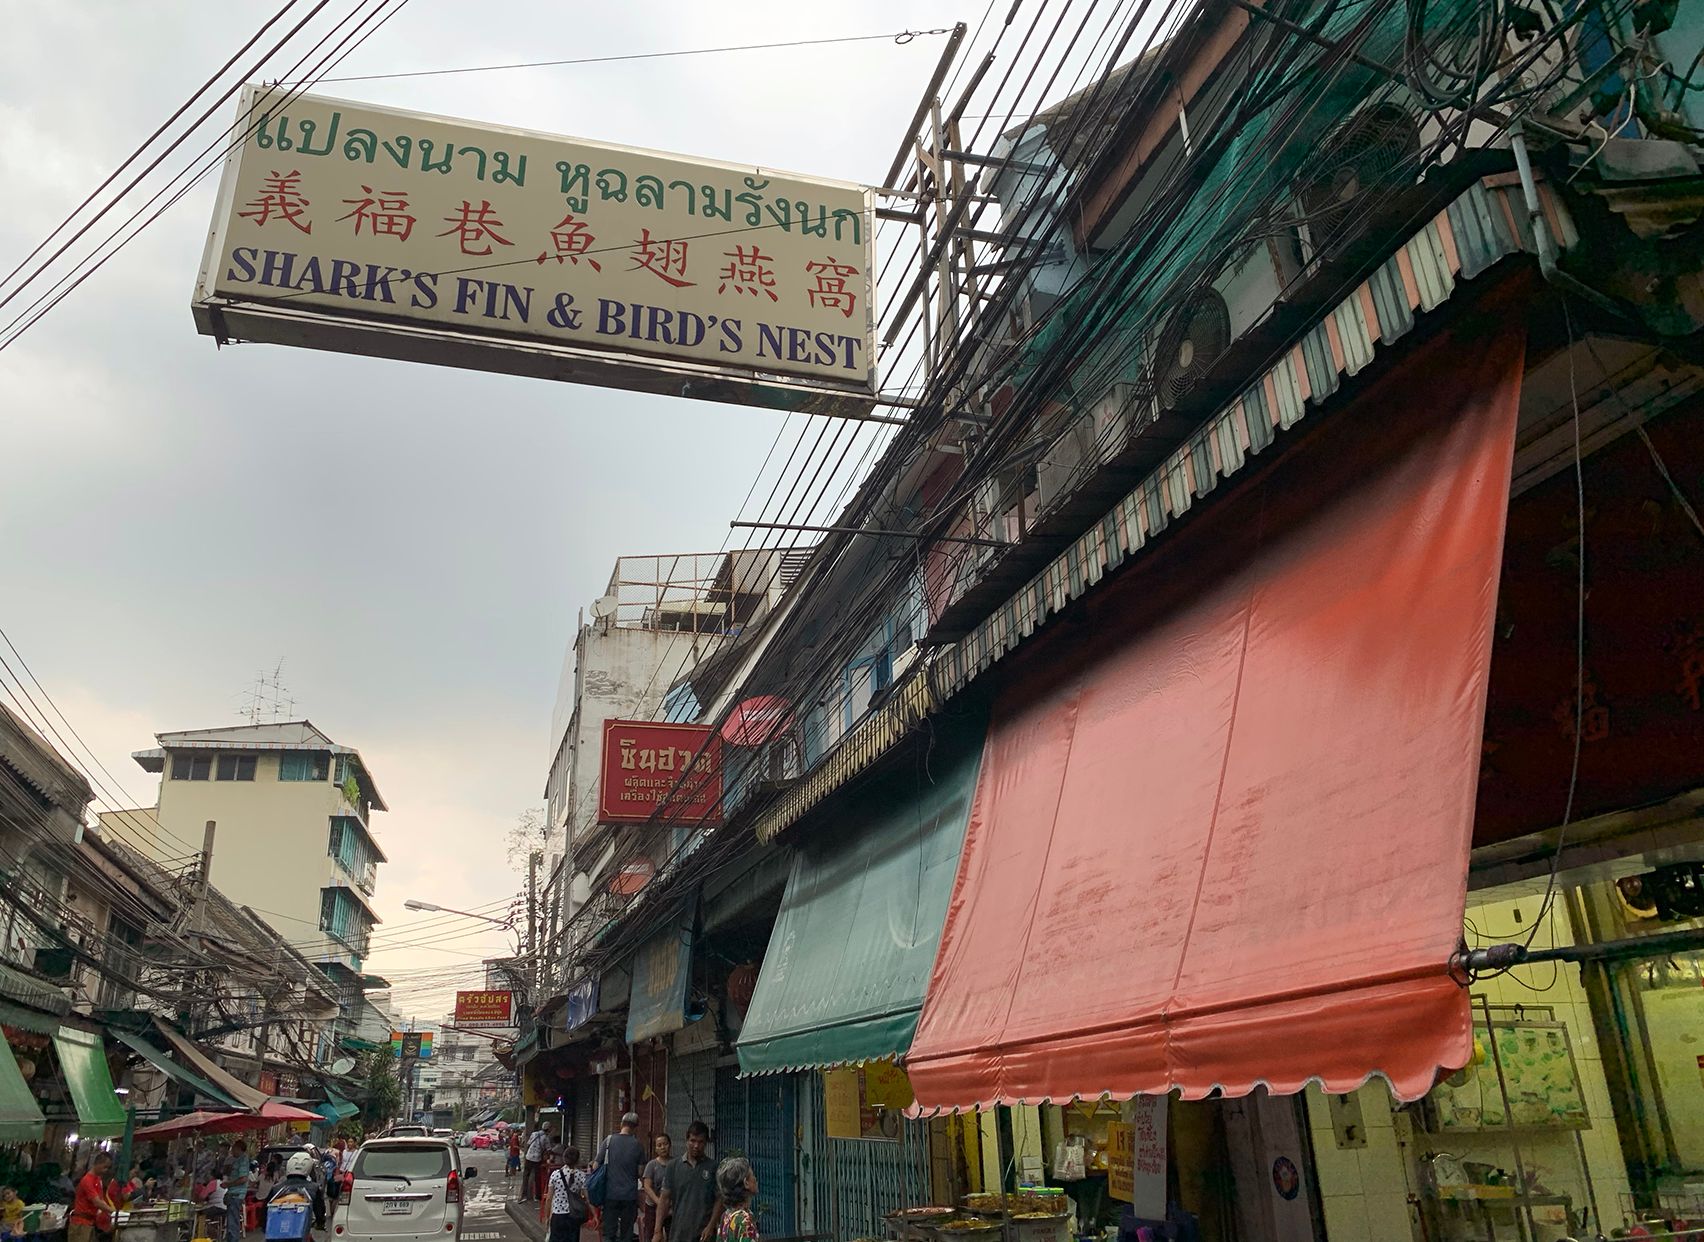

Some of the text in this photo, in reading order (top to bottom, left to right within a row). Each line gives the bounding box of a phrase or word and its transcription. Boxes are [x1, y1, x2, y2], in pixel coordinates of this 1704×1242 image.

[237, 170, 860, 318] 義福巷魚翅燕窩
[256, 112, 861, 245] แปลงนาม หูฉลามรังนก
[227, 247, 861, 370] SHARK'S FIN & BIRD'S NEST
